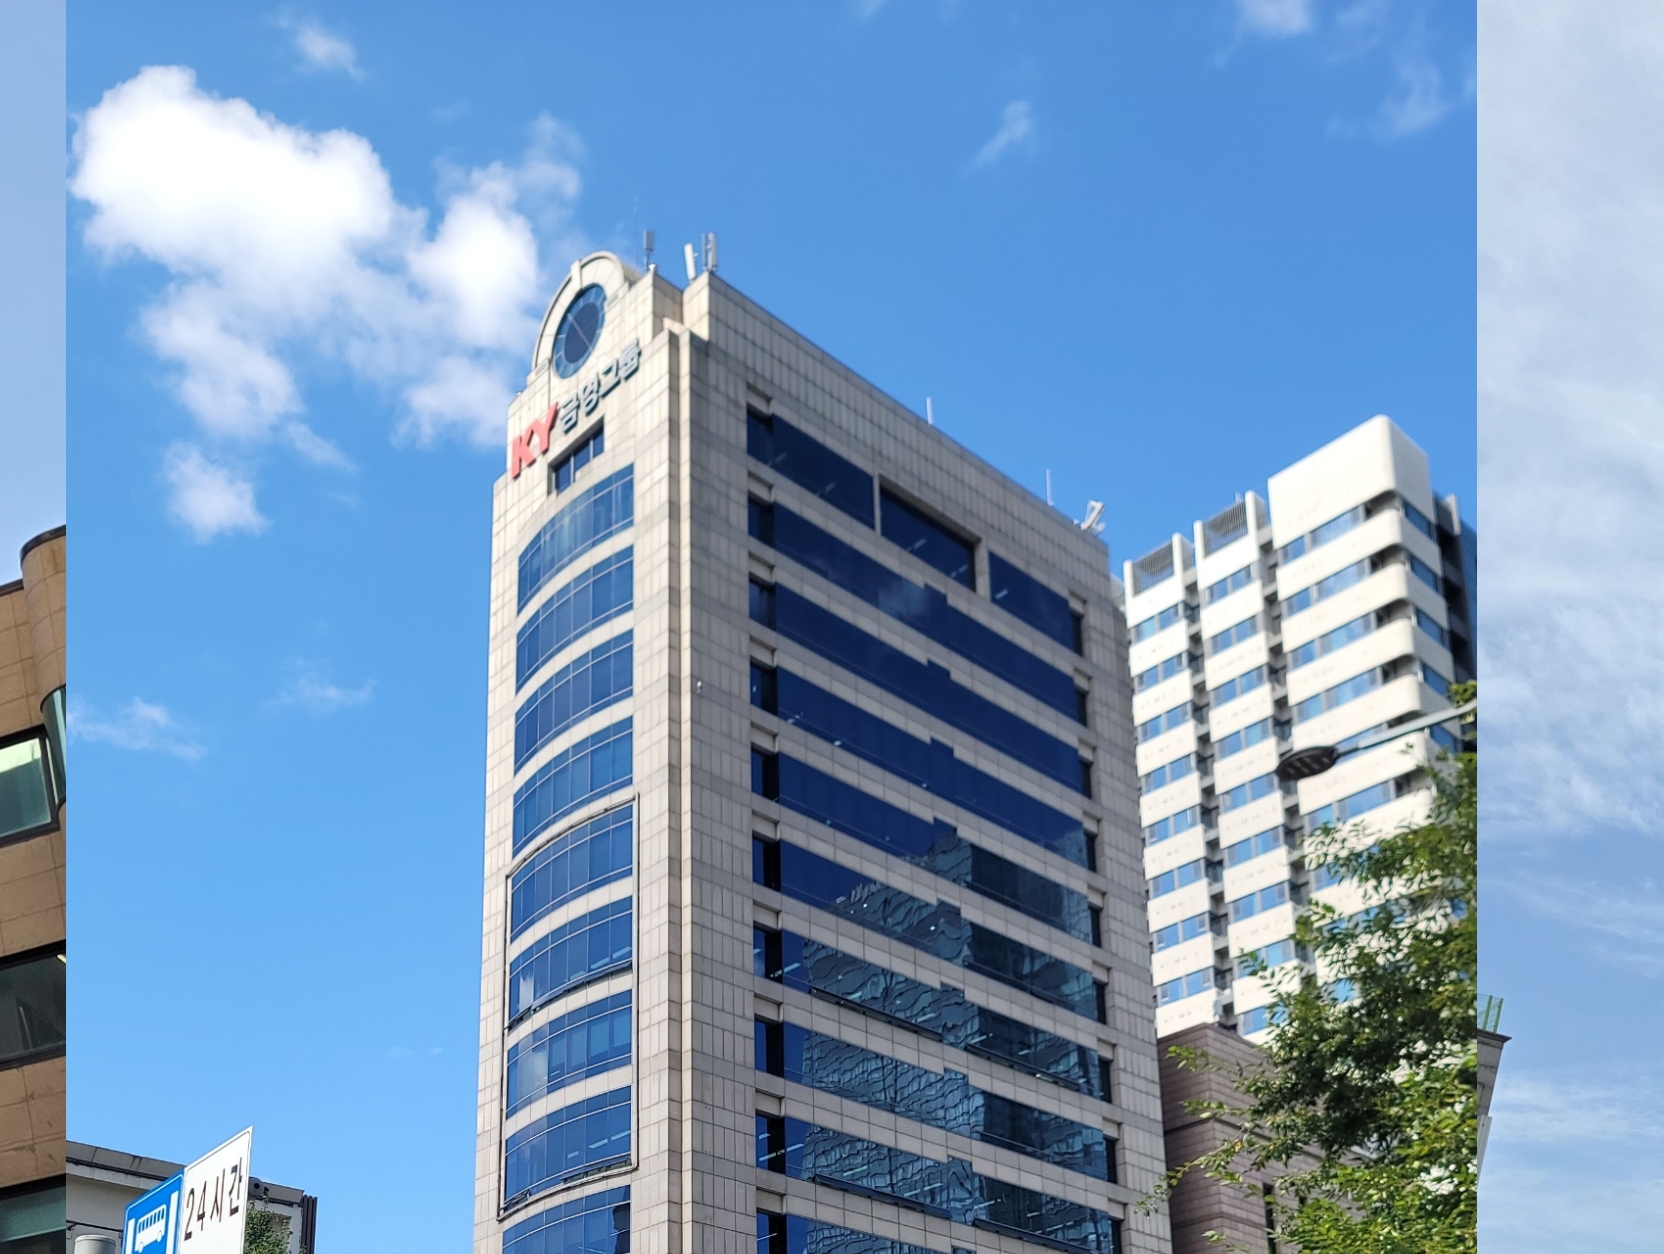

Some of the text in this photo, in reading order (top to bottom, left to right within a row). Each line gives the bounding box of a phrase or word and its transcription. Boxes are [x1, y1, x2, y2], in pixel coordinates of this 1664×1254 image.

[510, 338, 642, 481] KY 금영그룹
[184, 1157, 243, 1241] 24시간
